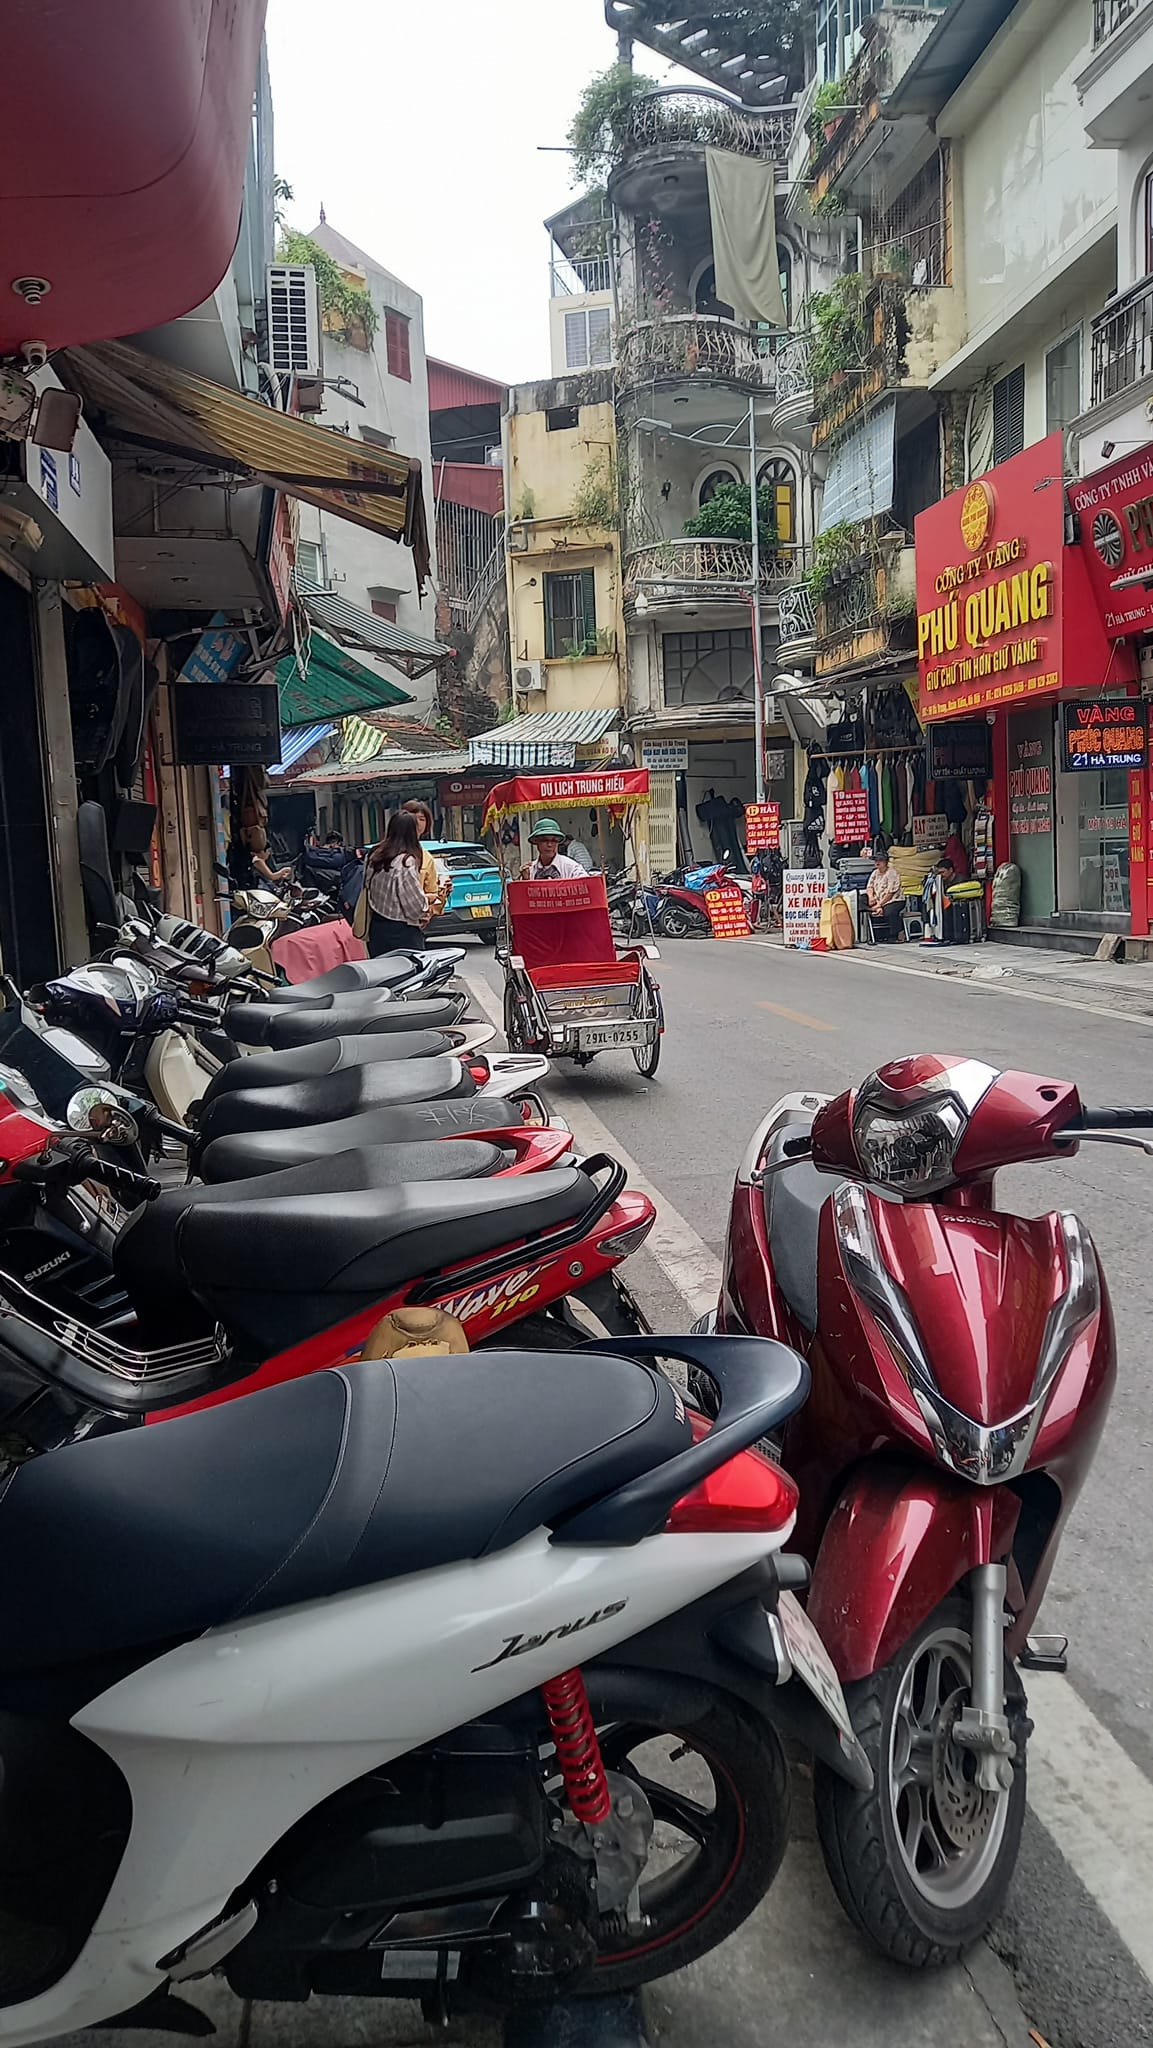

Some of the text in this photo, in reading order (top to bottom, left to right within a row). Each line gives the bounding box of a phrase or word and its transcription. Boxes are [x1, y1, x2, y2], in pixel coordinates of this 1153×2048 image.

[1074, 488, 1099, 512] CÔNG
[1098, 484, 1112, 500] TY
[1111, 468, 1141, 494] TNHH
[936, 566, 964, 594] CÔNG
[967, 556, 982, 580] TY
[918, 562, 1049, 660] PHÚ QUANG
[1105, 612, 1116, 628] 21
[1124, 606, 1146, 624] TRUNG
[1077, 705, 1135, 724] VÀNG
[1069, 724, 1144, 754] PHÚC QUANG
[1072, 753, 1142, 766] 21 HÀ TRUNG
[540, 782, 553, 797] DU
[575, 779, 603, 794] TRUNG
[605, 775, 624, 791] HIẾU
[1010, 763, 1050, 799] PHÚ QUANG
[785, 881, 825, 896] BỌC YÊN
[788, 898, 800, 908] XE
[586, 1030, 638, 1044] 29XL-0255
[942, 1215, 1000, 1228] HONDA
[24, 1251, 72, 1282] SUZUKI
[490, 1284, 540, 1320] 110
